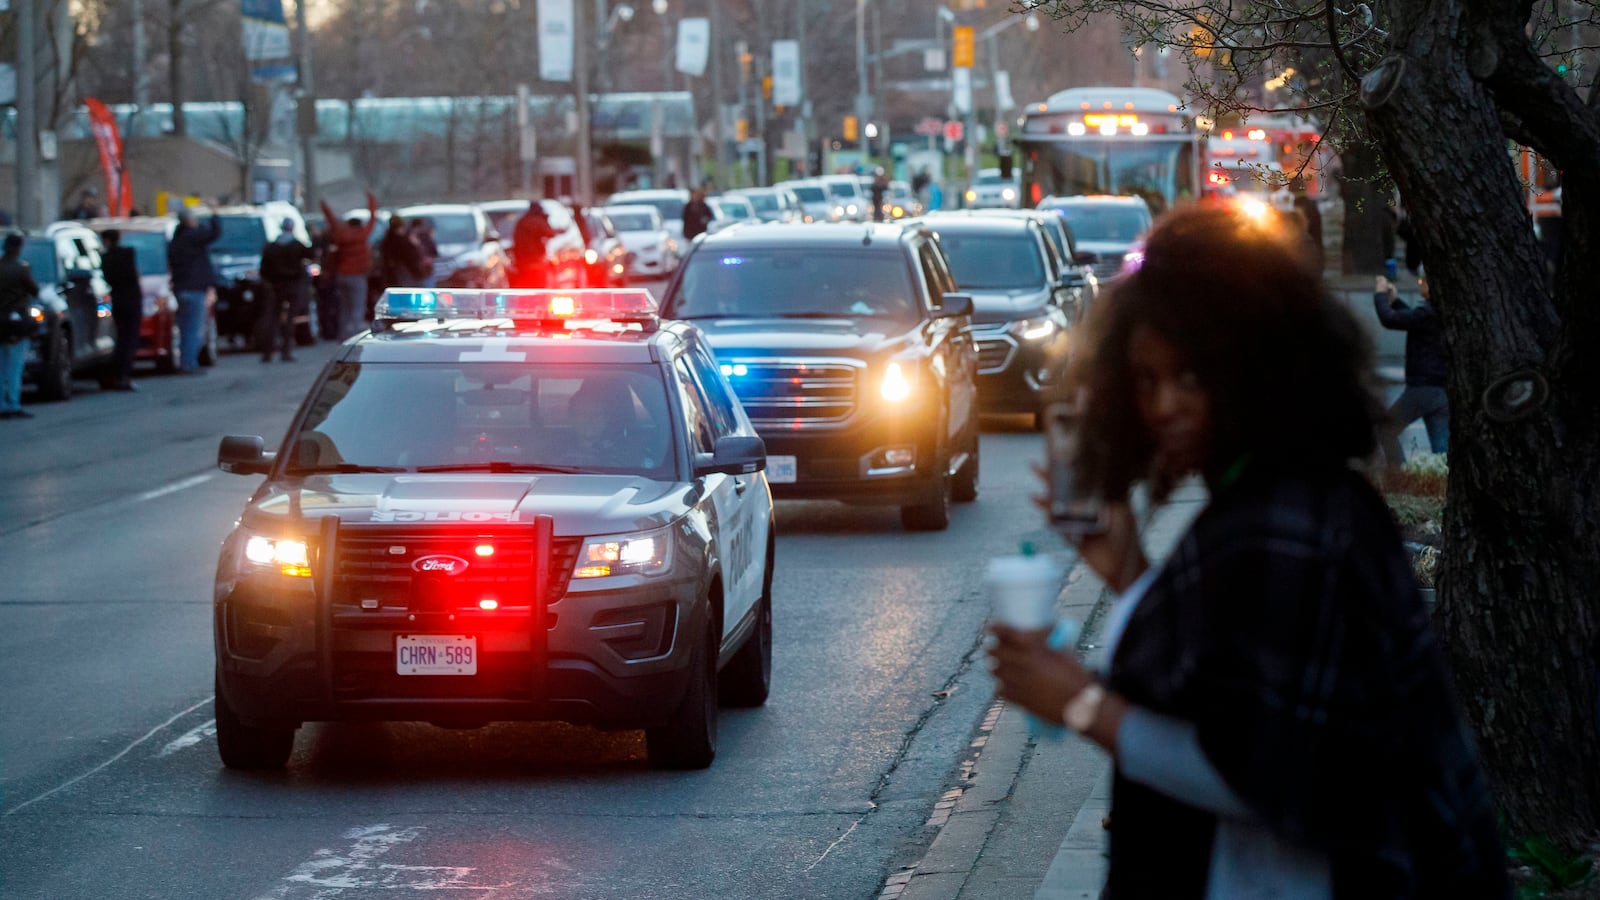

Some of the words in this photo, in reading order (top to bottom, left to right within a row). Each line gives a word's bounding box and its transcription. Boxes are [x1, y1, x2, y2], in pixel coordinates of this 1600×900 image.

[422, 559, 455, 571] Ford
[400, 645, 436, 665] CHRN
[445, 645, 473, 665] 589
